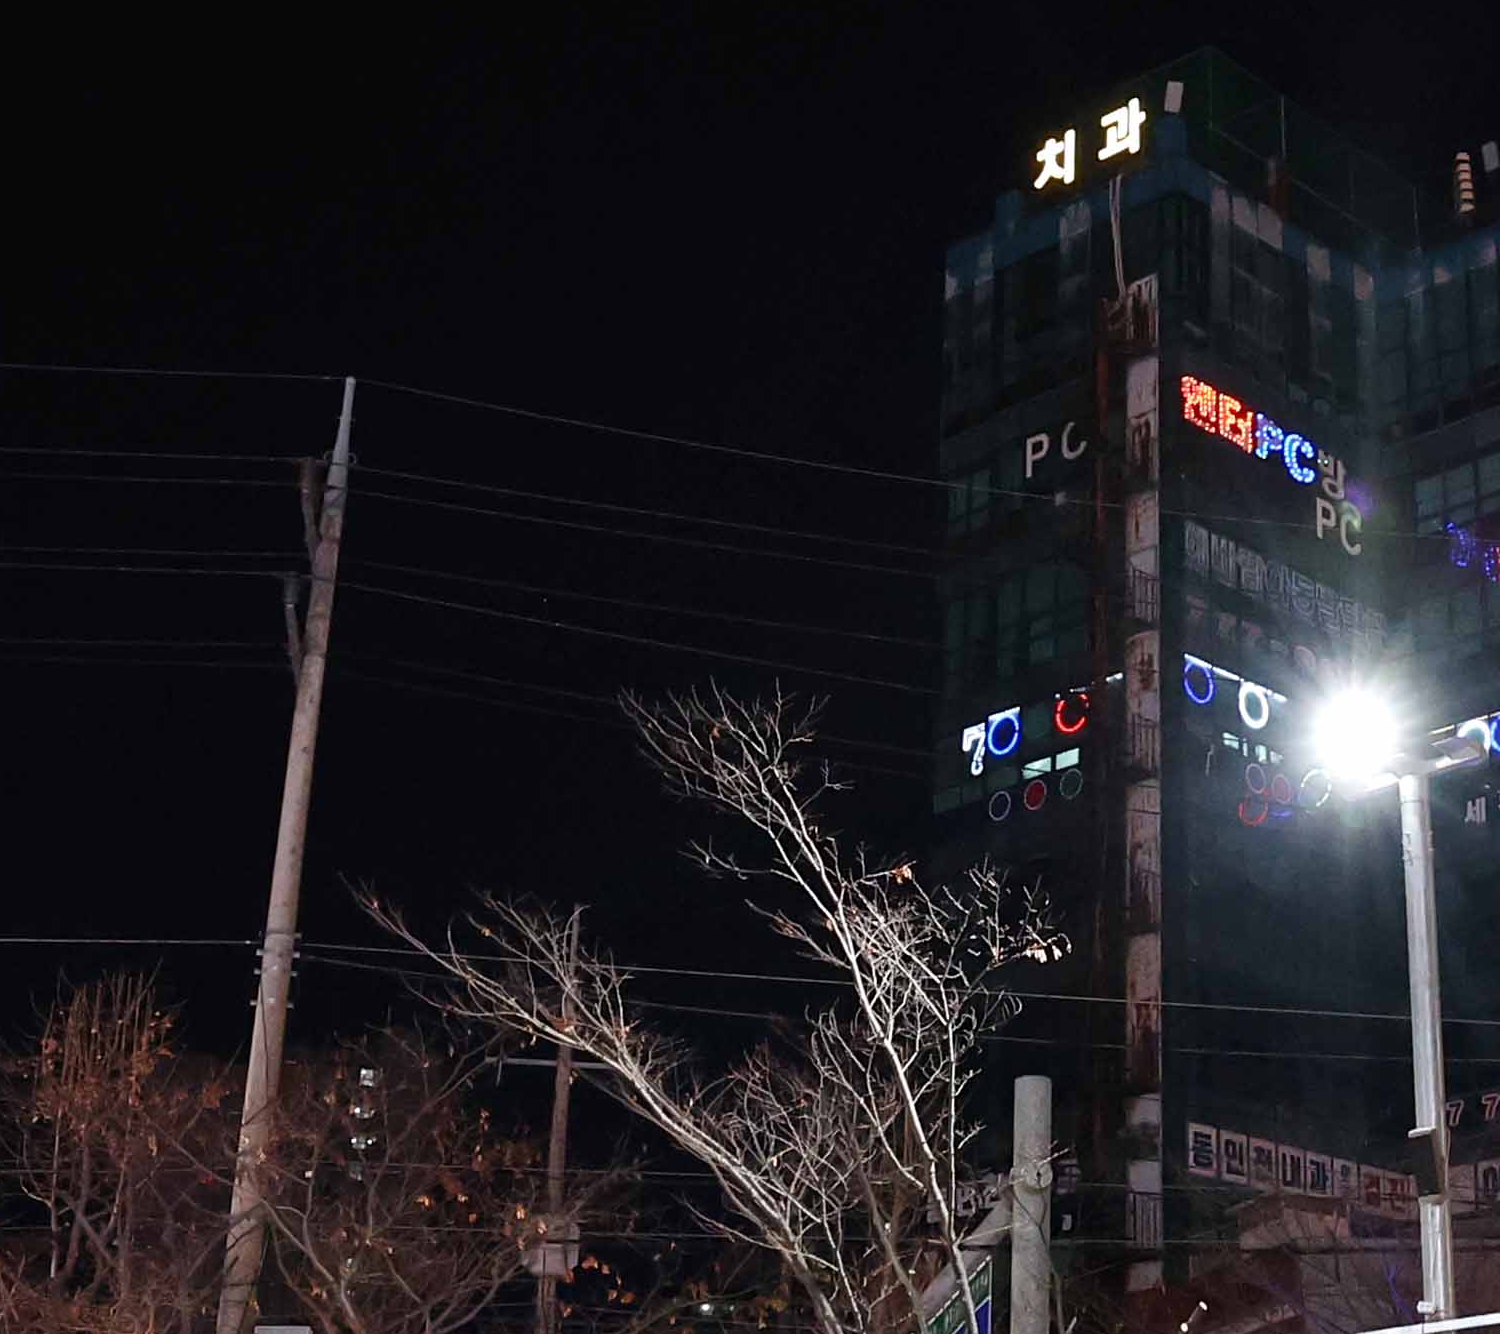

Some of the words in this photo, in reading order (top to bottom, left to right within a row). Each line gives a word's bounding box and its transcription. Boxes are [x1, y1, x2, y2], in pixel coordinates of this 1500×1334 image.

[1033, 96, 1147, 190] 치과
[1025, 420, 1088, 479] PC
[1316, 497, 1363, 556] PC
